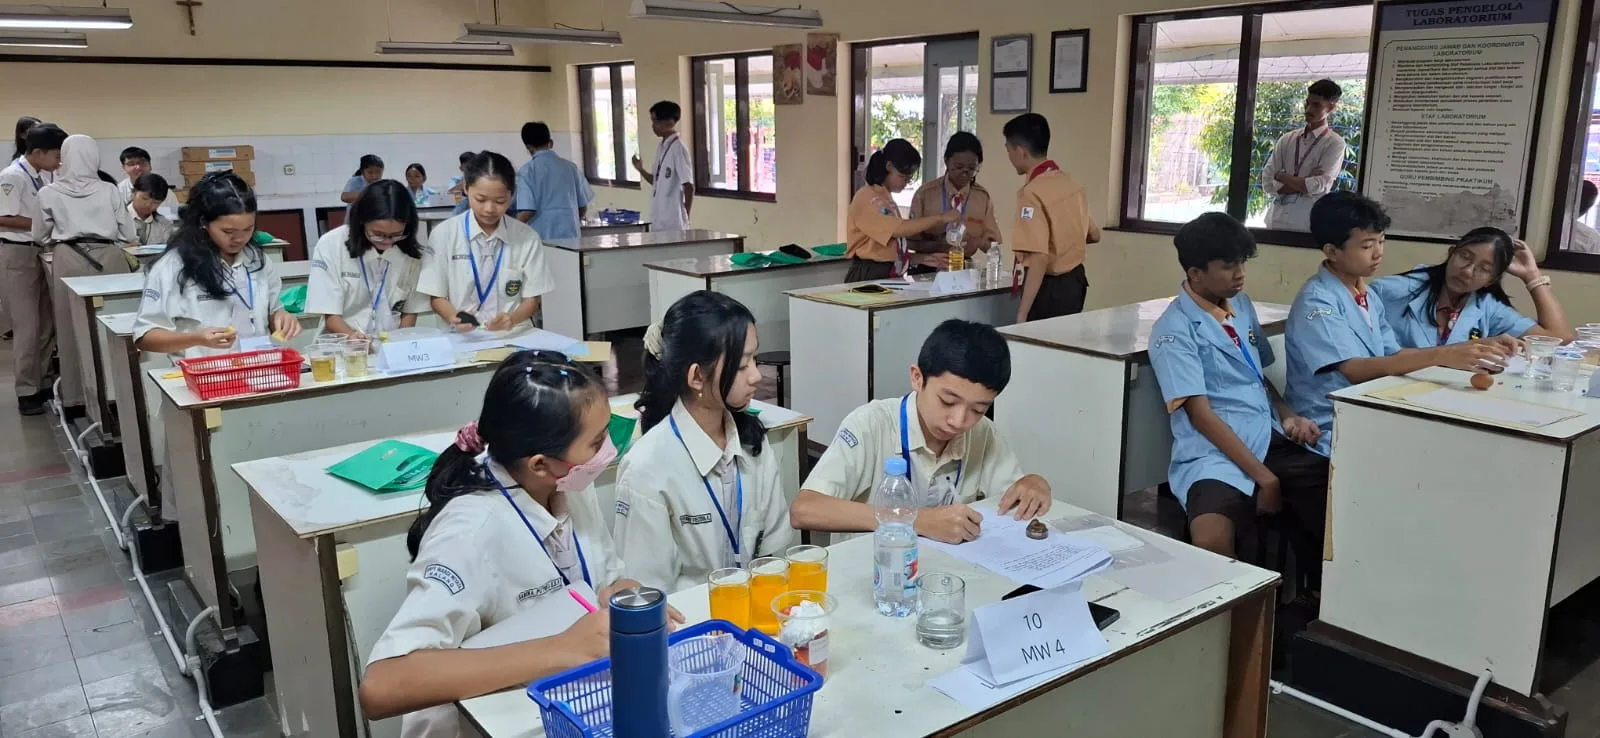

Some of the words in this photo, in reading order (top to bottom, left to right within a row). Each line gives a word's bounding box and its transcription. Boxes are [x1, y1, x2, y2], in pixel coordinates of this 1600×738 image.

[1406, 7, 1445, 18] TUGAS
[1448, 1, 1524, 16] PENGELOLA
[1412, 12, 1513, 26] LABORATORIUM
[1433, 49, 1482, 57] LABORATORIUM
[1023, 612, 1043, 631] 10
[1021, 641, 1052, 665] MW
[1055, 639, 1066, 654] 4
